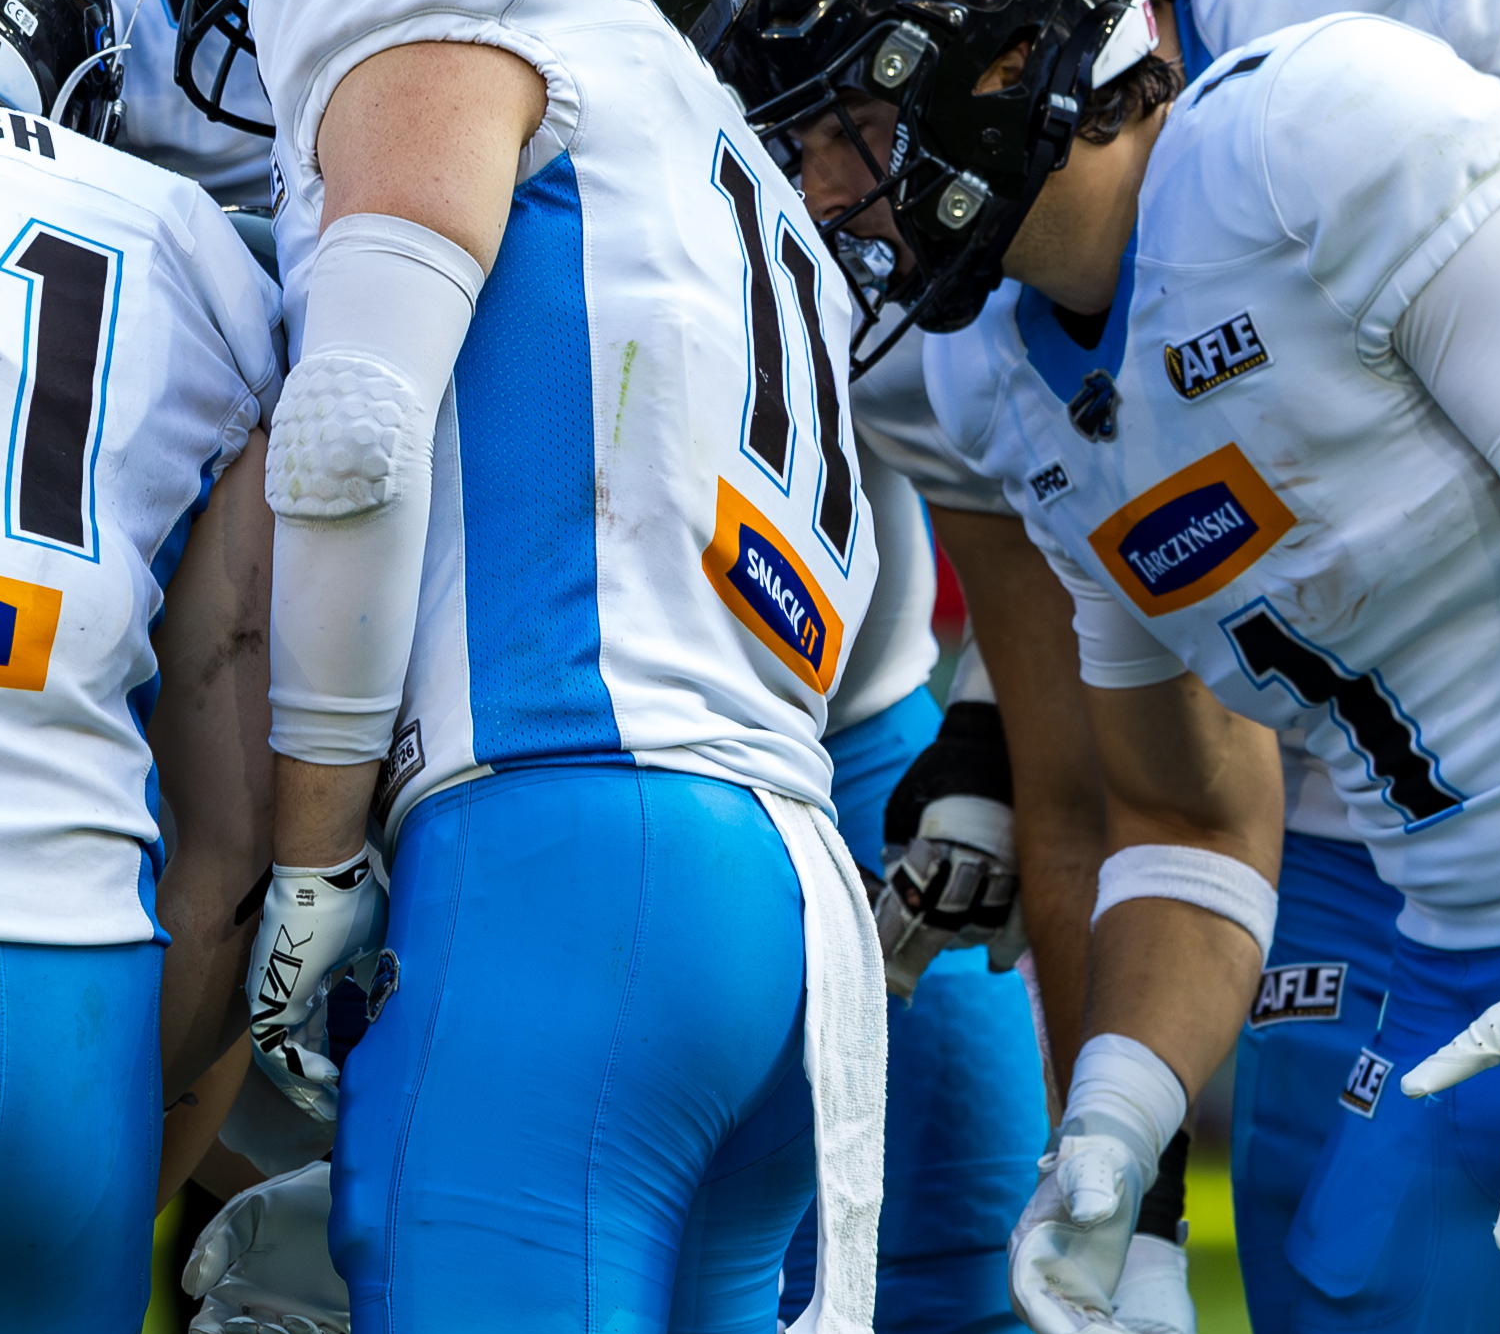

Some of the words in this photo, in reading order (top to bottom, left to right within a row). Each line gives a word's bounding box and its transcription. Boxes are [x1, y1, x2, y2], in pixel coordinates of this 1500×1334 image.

[711, 129, 865, 579] 11
[1180, 316, 1263, 390] AFLE
[1219, 596, 1465, 832] 1
[1255, 967, 1340, 1016] AFLE
[1346, 1054, 1387, 1104] FLE
